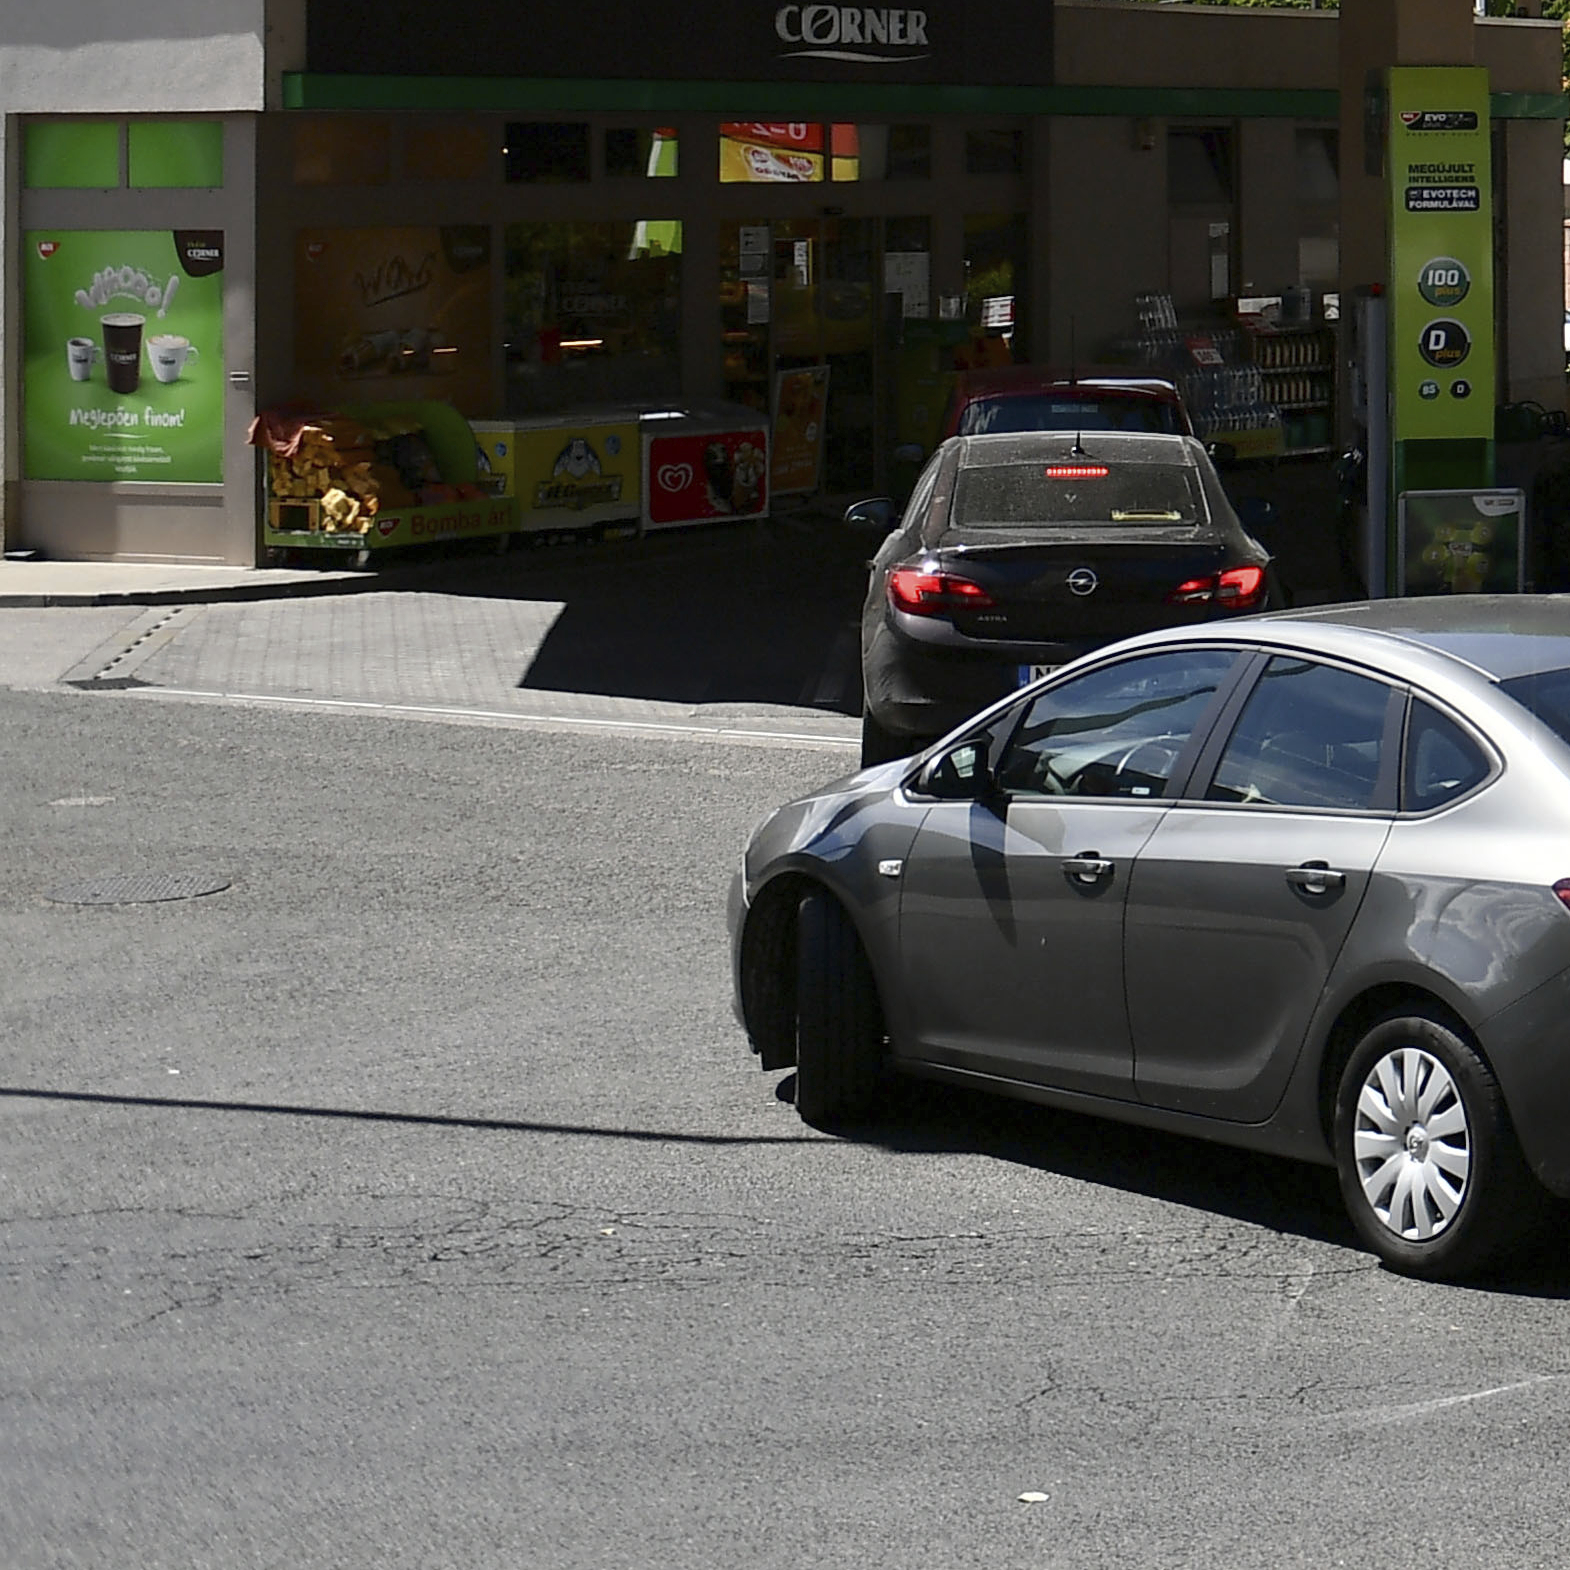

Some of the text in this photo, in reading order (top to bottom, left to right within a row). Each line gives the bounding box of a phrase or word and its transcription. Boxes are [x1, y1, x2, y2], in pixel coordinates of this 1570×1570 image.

[775, 4, 928, 45] CORNER
[1423, 190, 1476, 198] EVOTECH
[1428, 269, 1459, 285] 100
[1429, 330, 1445, 350] D
[144, 406, 184, 427] finom!
[411, 510, 481, 535] Bomba
[977, 614, 1008, 623] ASTRA
